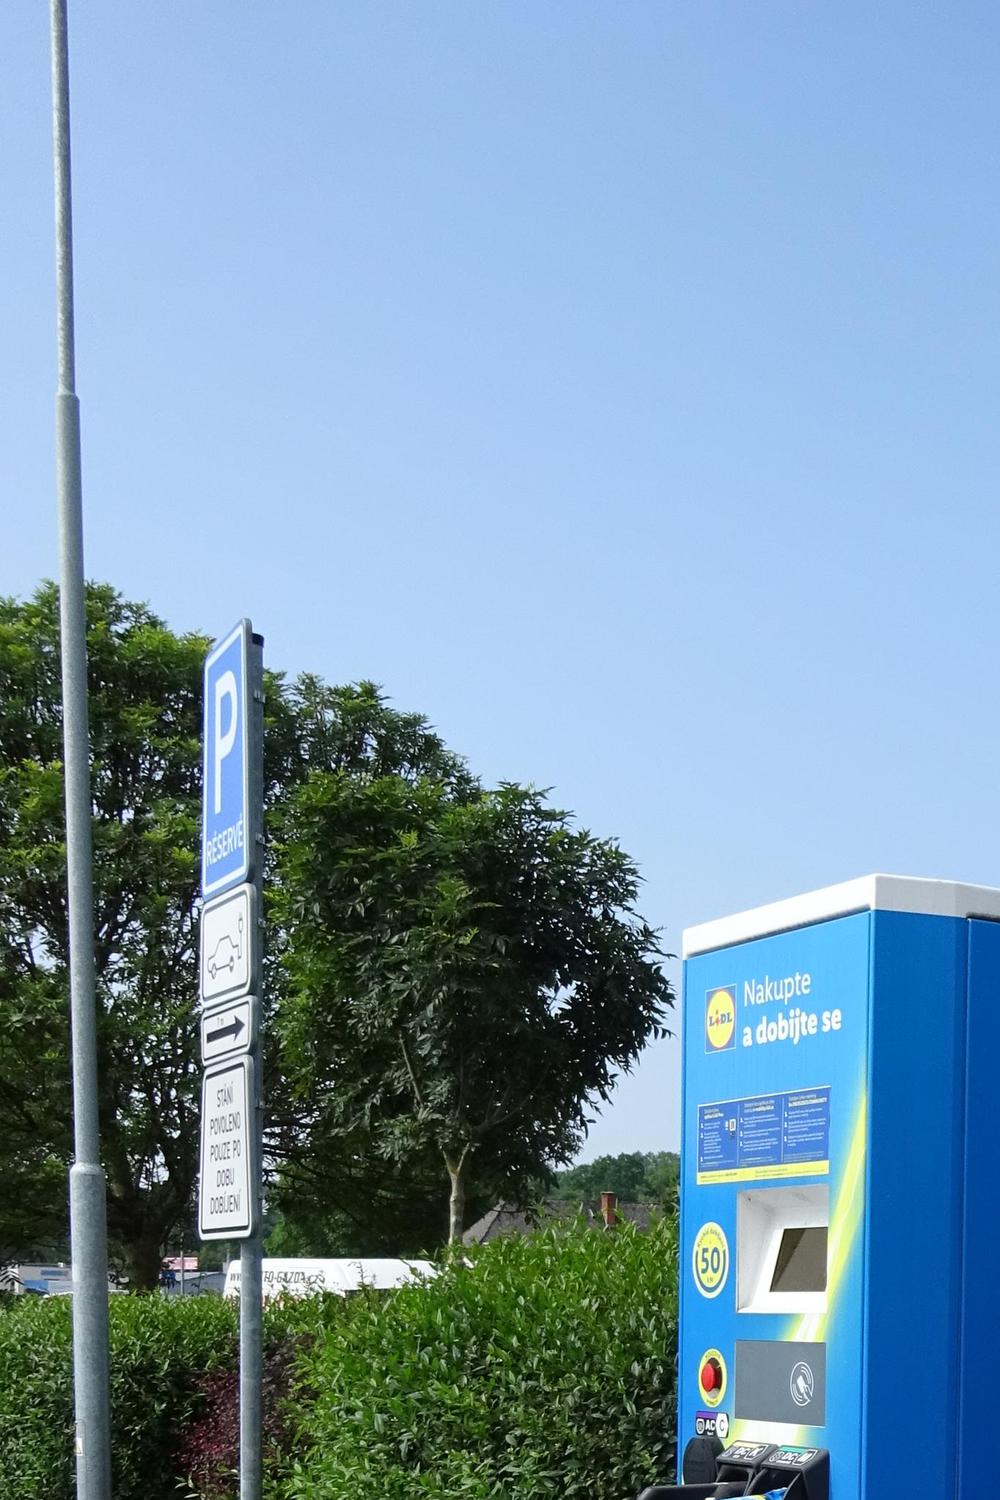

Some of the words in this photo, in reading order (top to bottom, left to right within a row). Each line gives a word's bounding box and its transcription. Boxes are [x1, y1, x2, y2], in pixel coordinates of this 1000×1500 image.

[214, 670, 238, 815] P
[743, 971, 812, 1007] Nakupte
[742, 1025, 753, 1048] a
[756, 1007, 818, 1045] dobijte
[821, 1008, 842, 1033] se
[216, 1081, 234, 1108] STÁNÍ
[210, 1112, 241, 1136] POVOLENO
[210, 1141, 231, 1163] POUZE
[233, 1139, 241, 1159] PO
[217, 1168, 235, 1188] DOBU
[210, 1188, 241, 1215] DOBÍJENÍ
[701, 1246, 721, 1275] 50
[705, 1418, 716, 1432] AC
[719, 1419, 725, 1432] C
